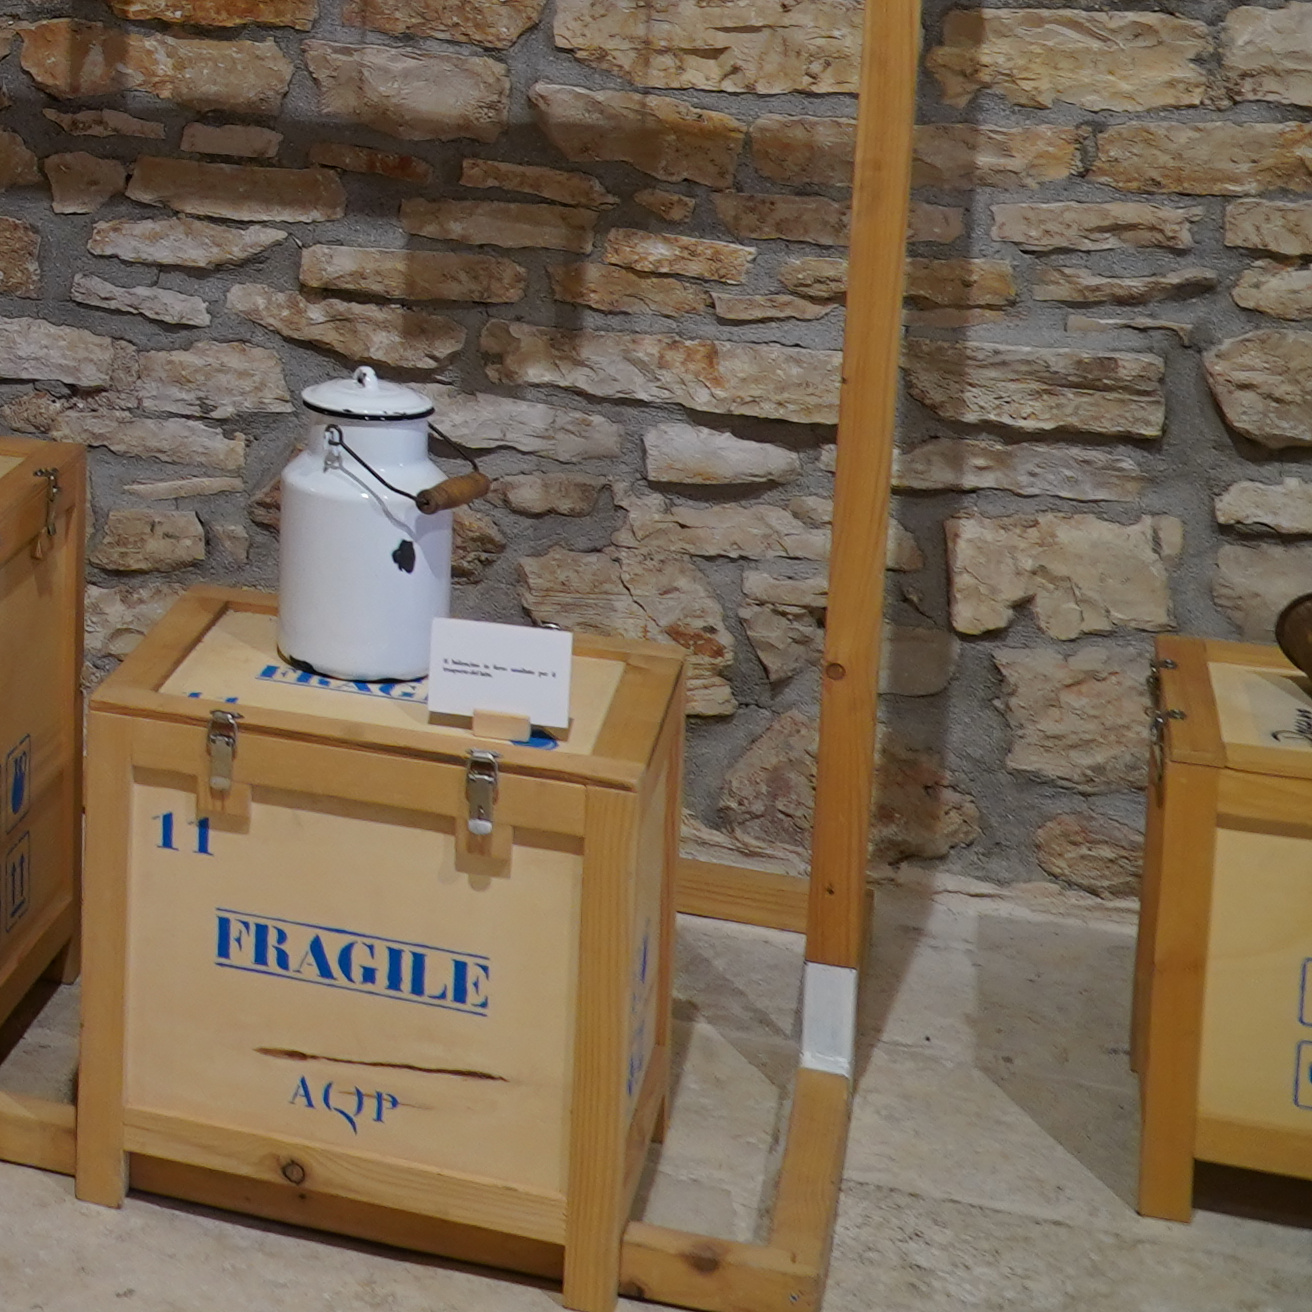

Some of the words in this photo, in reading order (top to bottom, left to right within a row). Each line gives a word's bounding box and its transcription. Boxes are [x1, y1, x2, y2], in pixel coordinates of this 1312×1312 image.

[151, 811, 214, 856] 11
[215, 915, 490, 1009] FRAGILE
[289, 1076, 400, 1135] AQP
